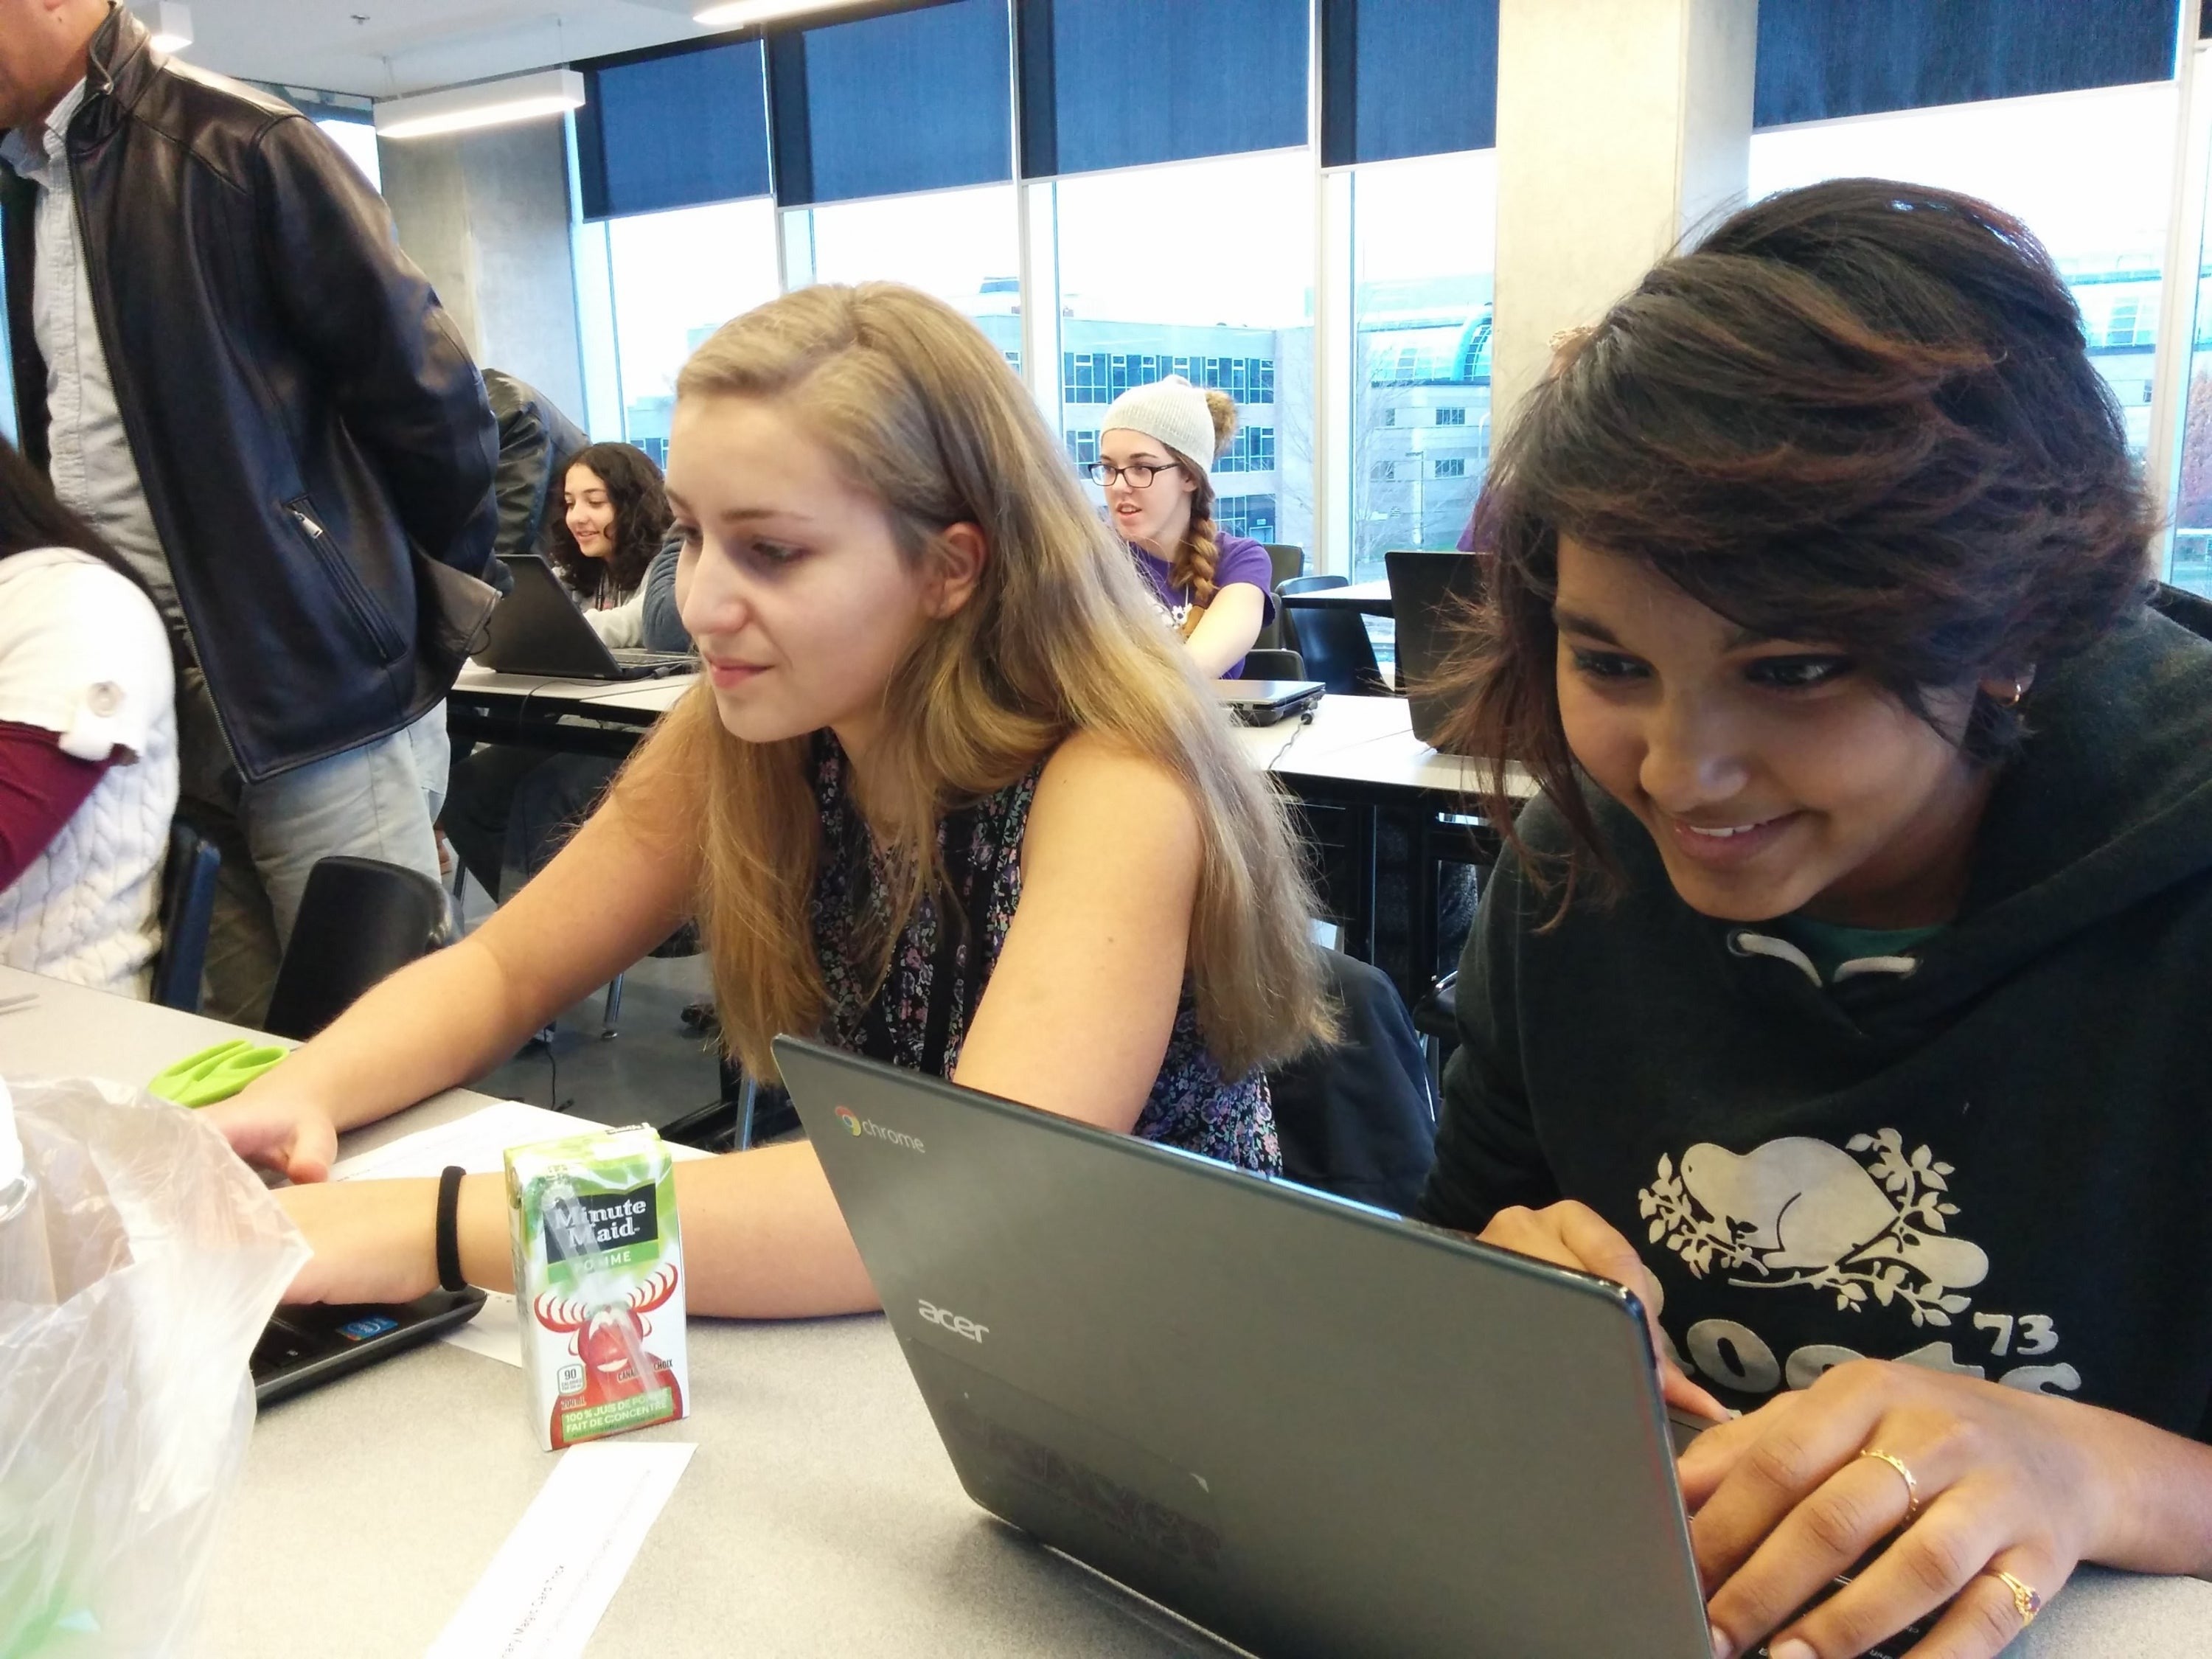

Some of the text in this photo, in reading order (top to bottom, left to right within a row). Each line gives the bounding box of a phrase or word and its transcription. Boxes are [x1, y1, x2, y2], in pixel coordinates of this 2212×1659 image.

[862, 1119, 925, 1152] chrome
[554, 1199, 647, 1229] Minute
[568, 1217, 636, 1248] Maid
[574, 1251, 631, 1273] OME
[919, 1299, 990, 1343] acer
[1973, 1312, 2059, 1356] 73
[564, 1368, 577, 1380] 90
[653, 1359, 673, 1371] CHOIX
[566, 1411, 583, 1423] 100
[593, 1403, 616, 1417] JUS
[632, 1387, 668, 1406] POE
[566, 1420, 590, 1433] FAIT
[590, 1417, 604, 1427] DE
